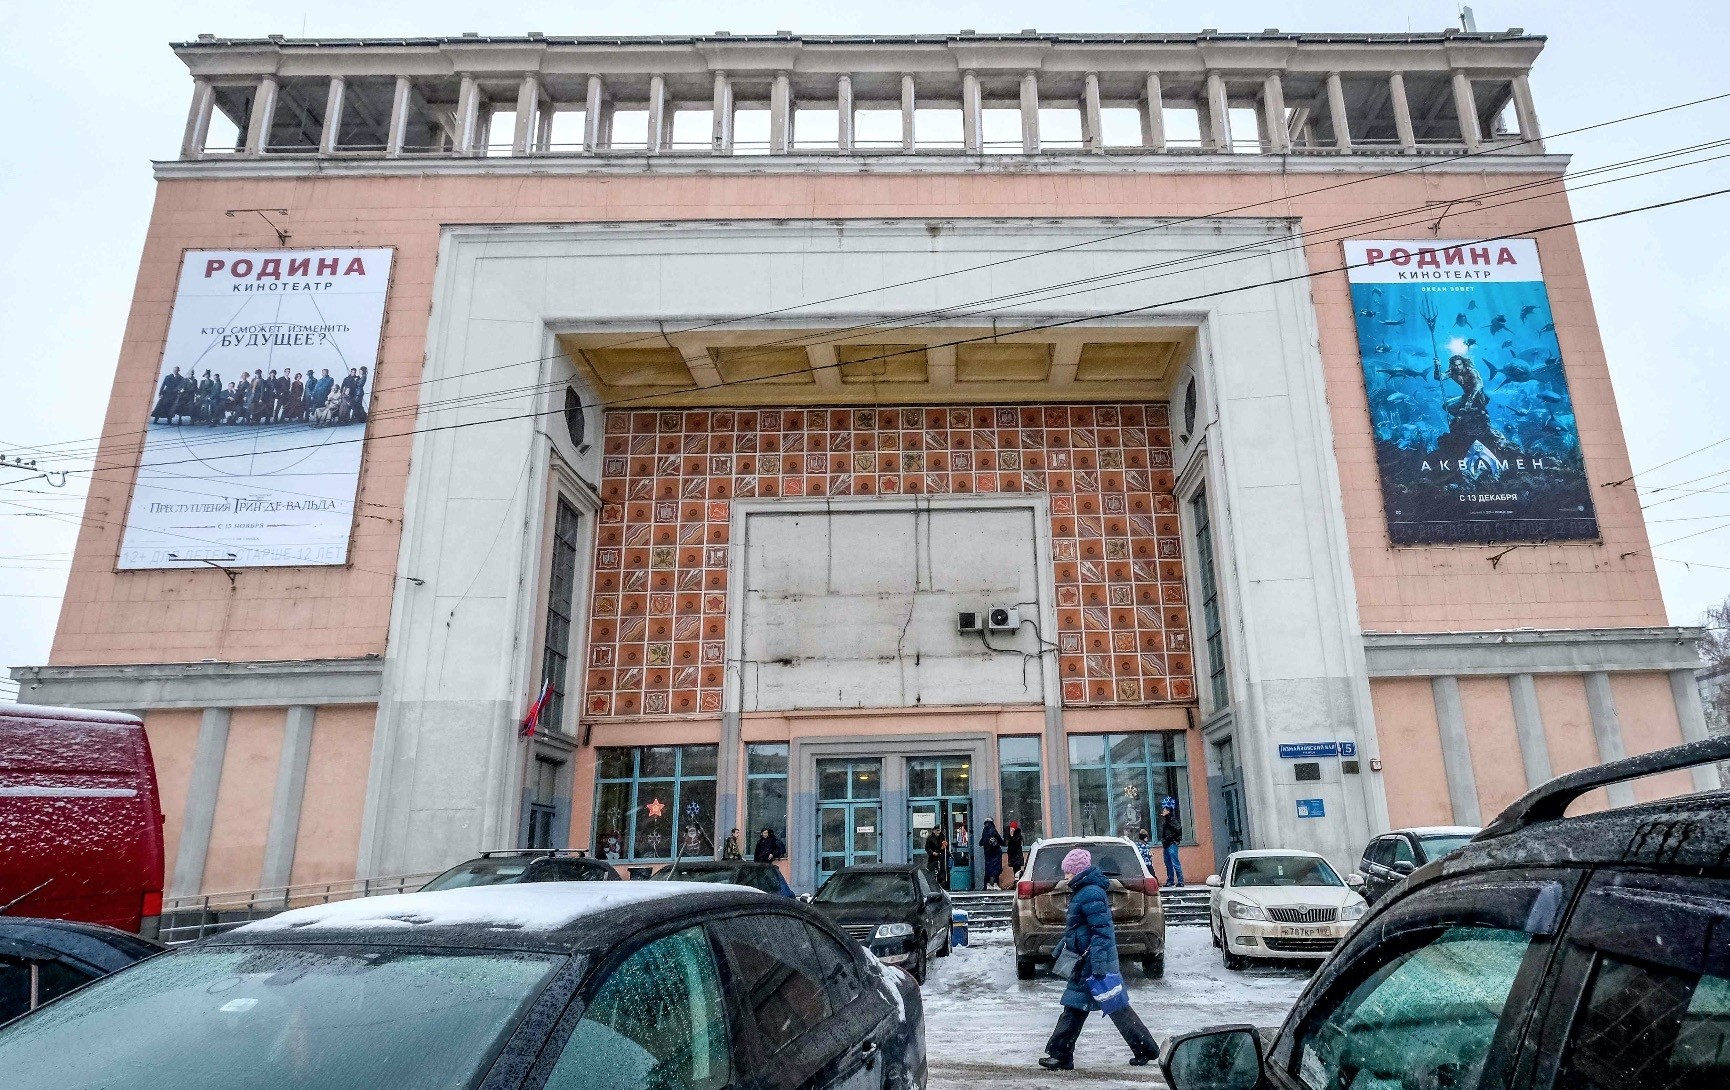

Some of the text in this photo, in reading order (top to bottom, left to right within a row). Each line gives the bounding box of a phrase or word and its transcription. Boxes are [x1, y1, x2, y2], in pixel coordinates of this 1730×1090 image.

[1365, 247, 1518, 269] РОДИНА
[204, 257, 366, 281] РОДИНА
[1398, 270, 1491, 280] КИНОТЕАТР
[232, 282, 333, 292] КИНОТЕАТР
[201, 324, 350, 335] КТО СМОЖЕТ ИЗМЕНИТЬ
[221, 332, 327, 347] БУДУЩЕЕ?
[1421, 459, 1544, 472] АКВАМЕН
[1459, 493, 1518, 503] С 13 ДЕКАБРЯ
[123, 551, 146, 563] 12+
[236, 548, 292, 560] СТАРШЕ
[298, 547, 312, 560] 12
[315, 547, 343, 560] ЛЕТ
[1345, 744, 1352, 753] 5
